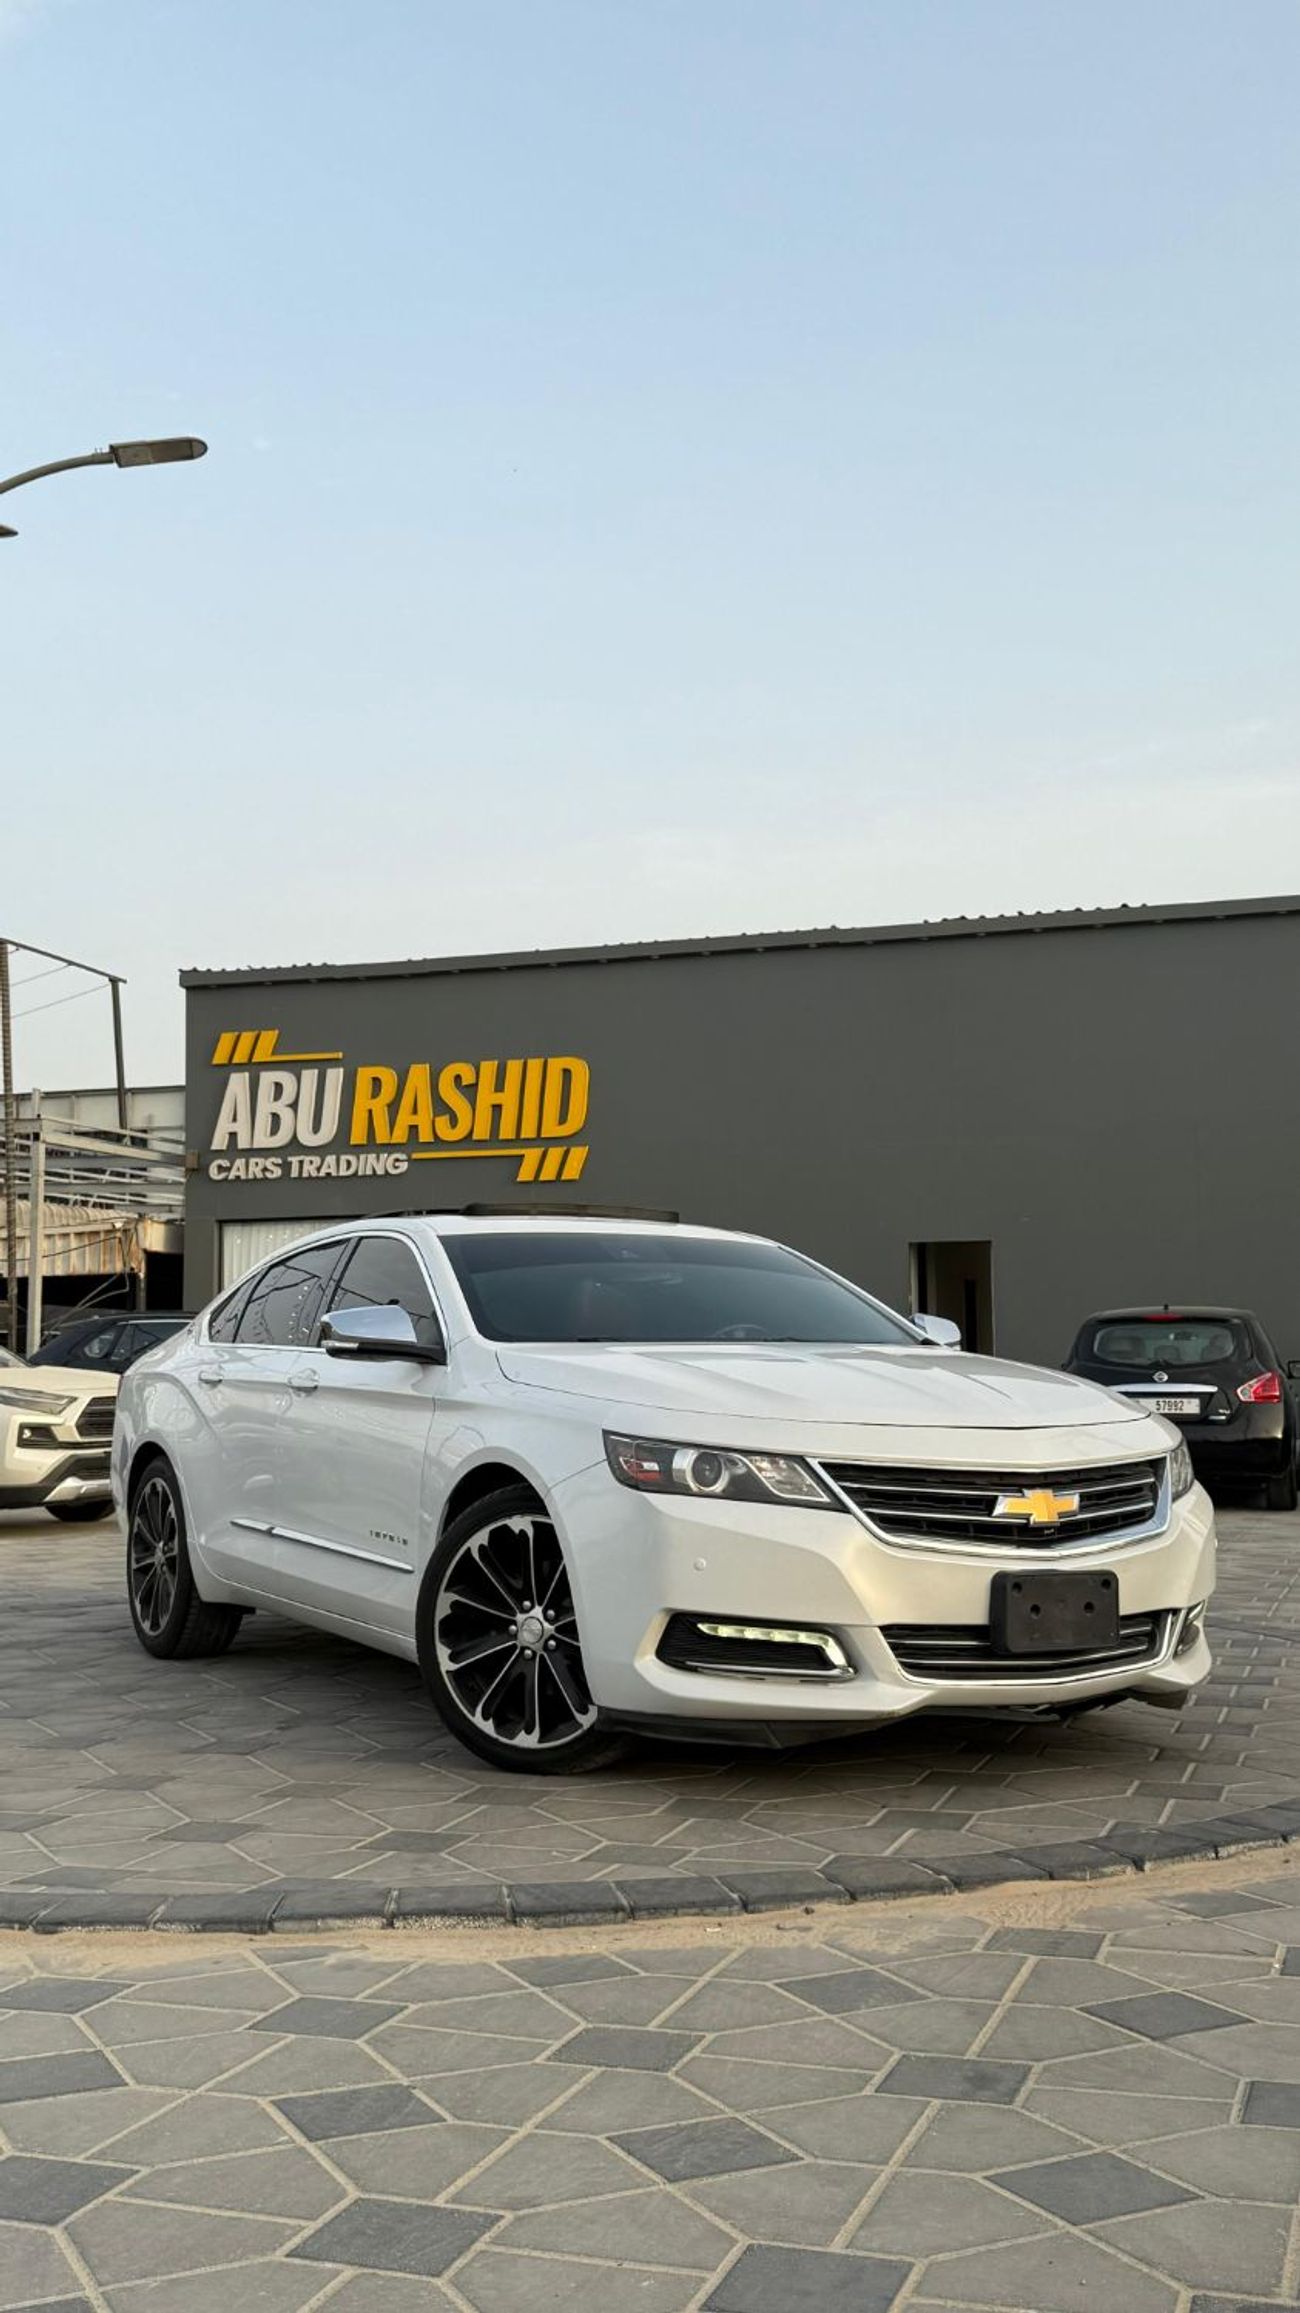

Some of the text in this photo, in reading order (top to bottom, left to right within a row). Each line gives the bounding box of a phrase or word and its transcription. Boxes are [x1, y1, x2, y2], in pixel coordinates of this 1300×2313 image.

[210, 1057, 591, 1151] ABU RASHID
[208, 1153, 409, 1181] CARS TRADING
